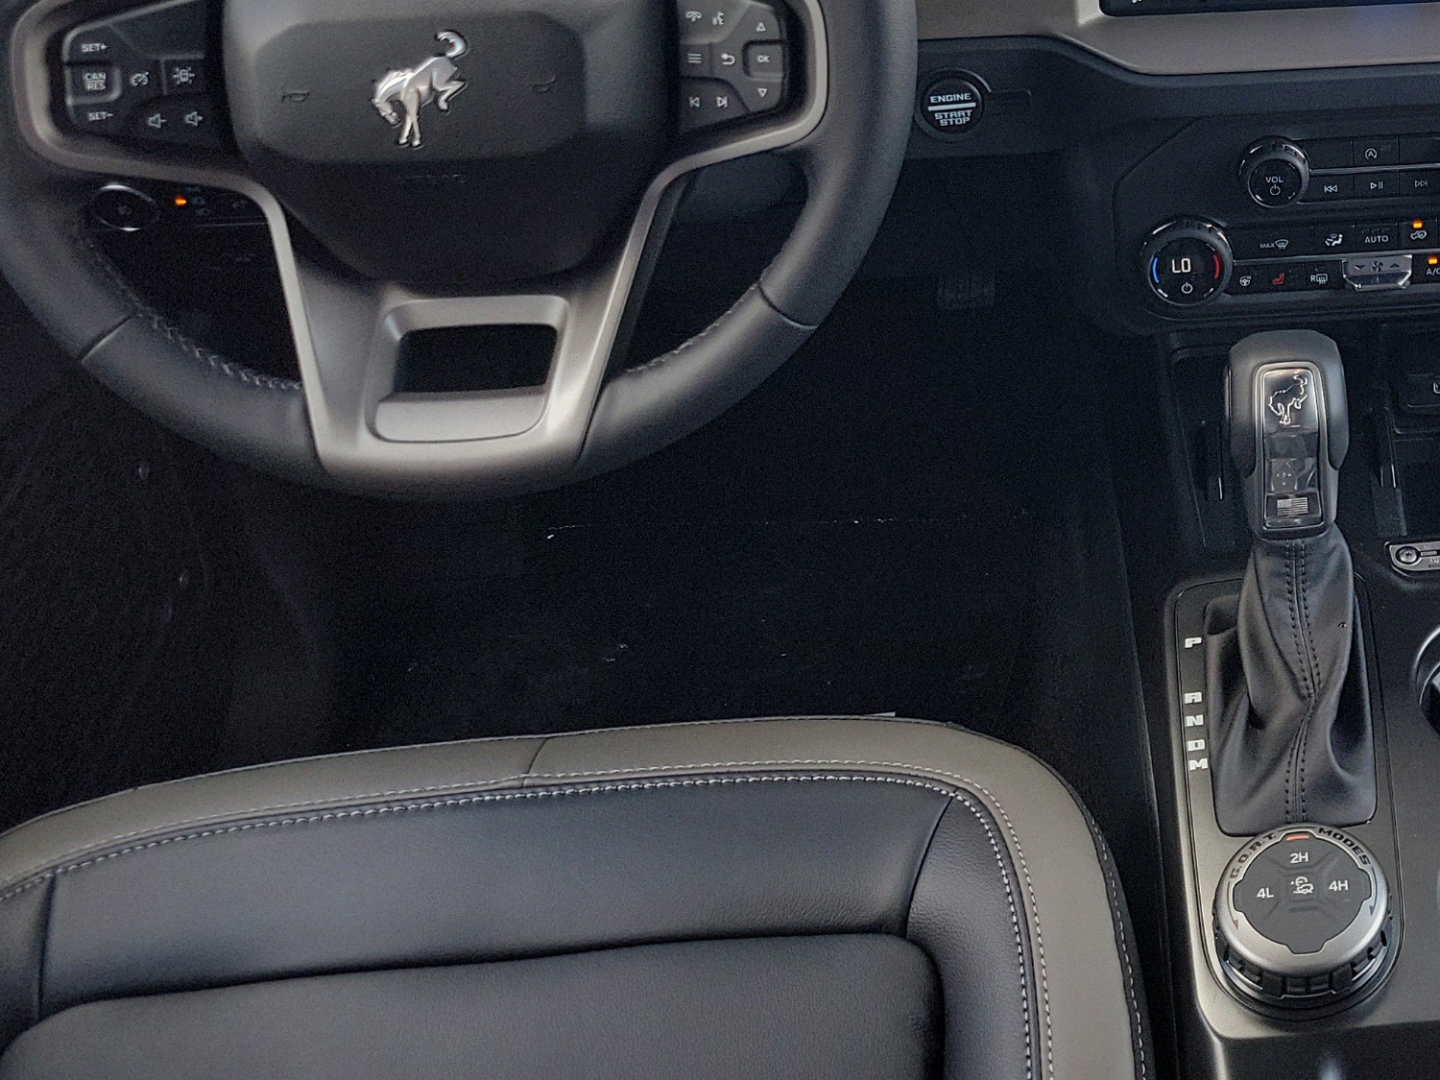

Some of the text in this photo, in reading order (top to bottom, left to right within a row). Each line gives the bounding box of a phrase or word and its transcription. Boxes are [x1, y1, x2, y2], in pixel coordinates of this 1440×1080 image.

[757, 54, 770, 63] OK
[930, 93, 972, 103] ENGINE
[934, 110, 973, 120] START
[940, 117, 970, 126] STOP
[1265, 176, 1284, 184] VOL
[1364, 235, 1389, 244] AUTO
[1172, 258, 1192, 274] LO
[1184, 637, 1202, 648] P
[1186, 714, 1204, 727] N
[1187, 739, 1206, 752] D
[1188, 758, 1208, 771] M
[1318, 827, 1371, 866] MODES
[1290, 852, 1308, 864] 2H
[1256, 880, 1348, 898] 4L 4H
